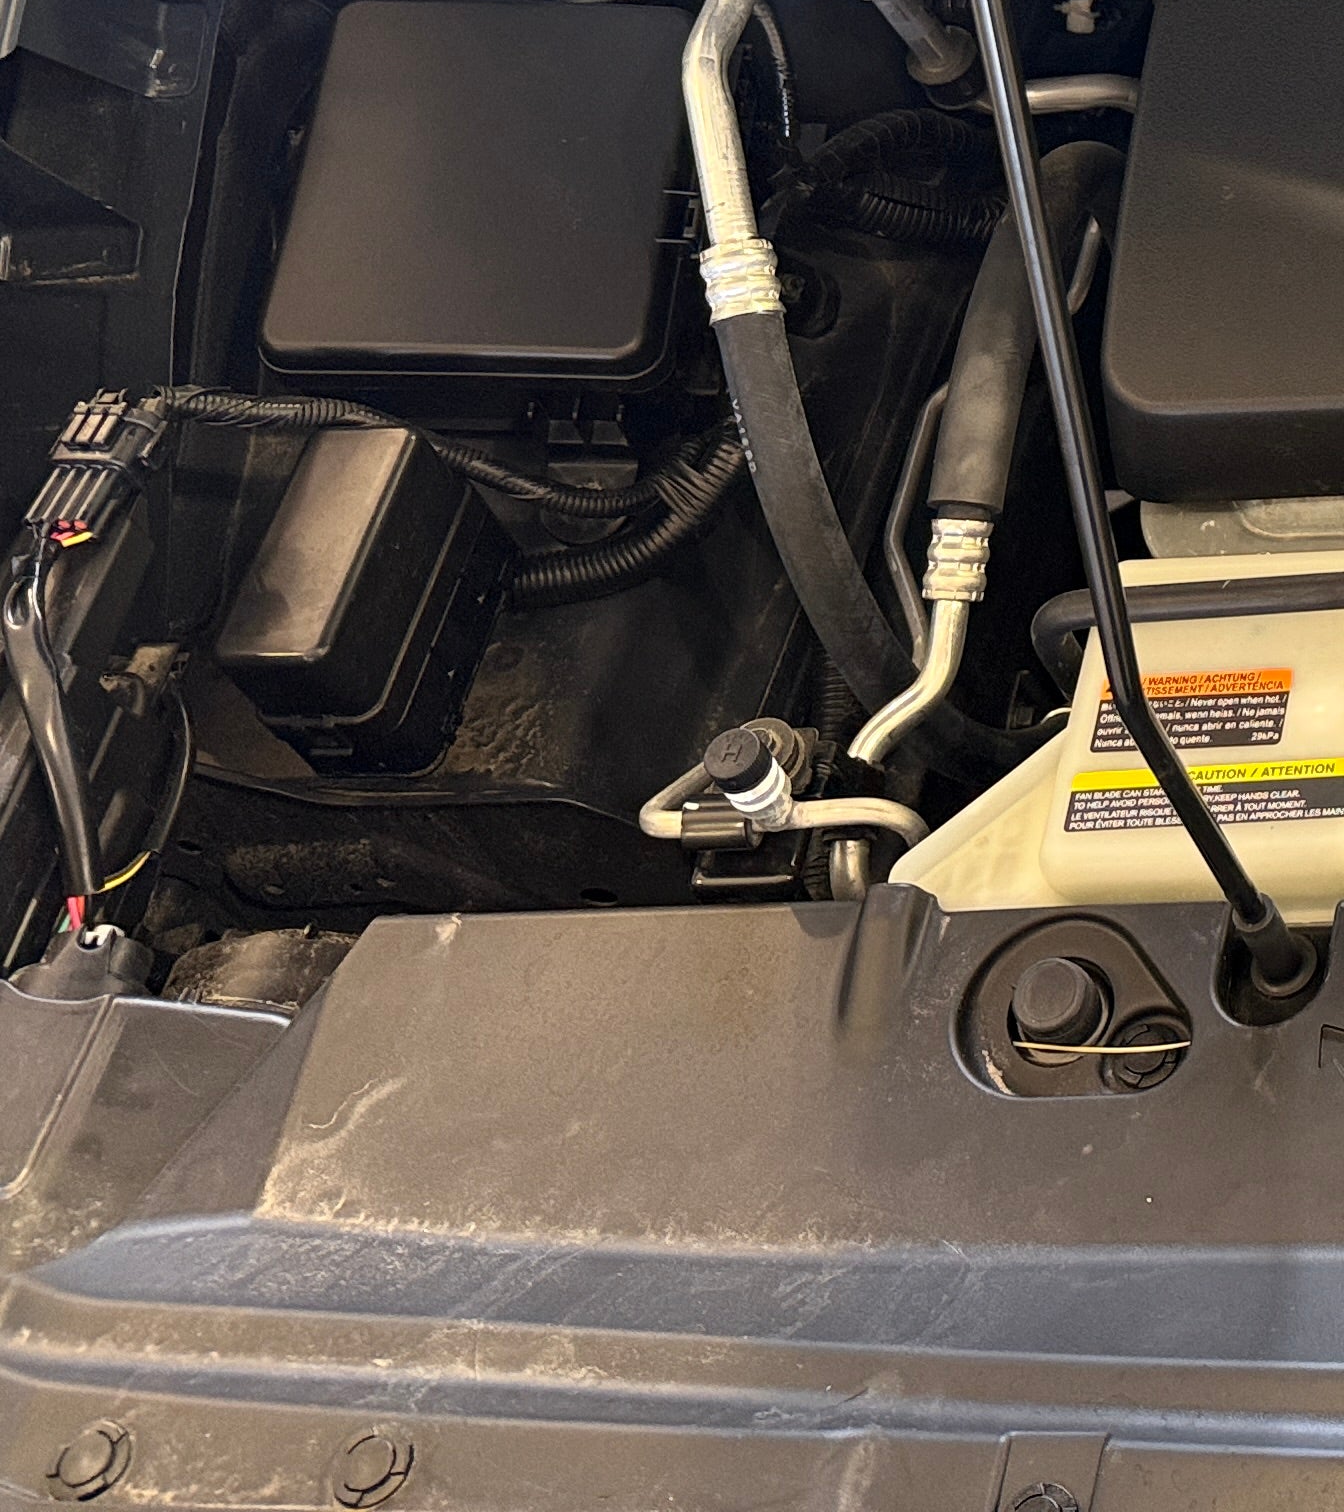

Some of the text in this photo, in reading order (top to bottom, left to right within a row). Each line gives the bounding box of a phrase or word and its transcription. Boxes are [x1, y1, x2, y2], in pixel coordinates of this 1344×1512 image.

[1148, 676, 1197, 685] WARNING
[1205, 673, 1255, 682] ACHTUNG
[1145, 683, 1205, 695] TISSEMENT
[1211, 681, 1284, 692] ADVERTENCIA
[1189, 769, 1246, 781] CAUTION
[1261, 763, 1336, 777] ATTENTION
[1094, 791, 1122, 799] BLADE
[1087, 801, 1109, 809] HELP
[1138, 798, 1170, 806] PERSO
[1155, 817, 1183, 826] BLESS
